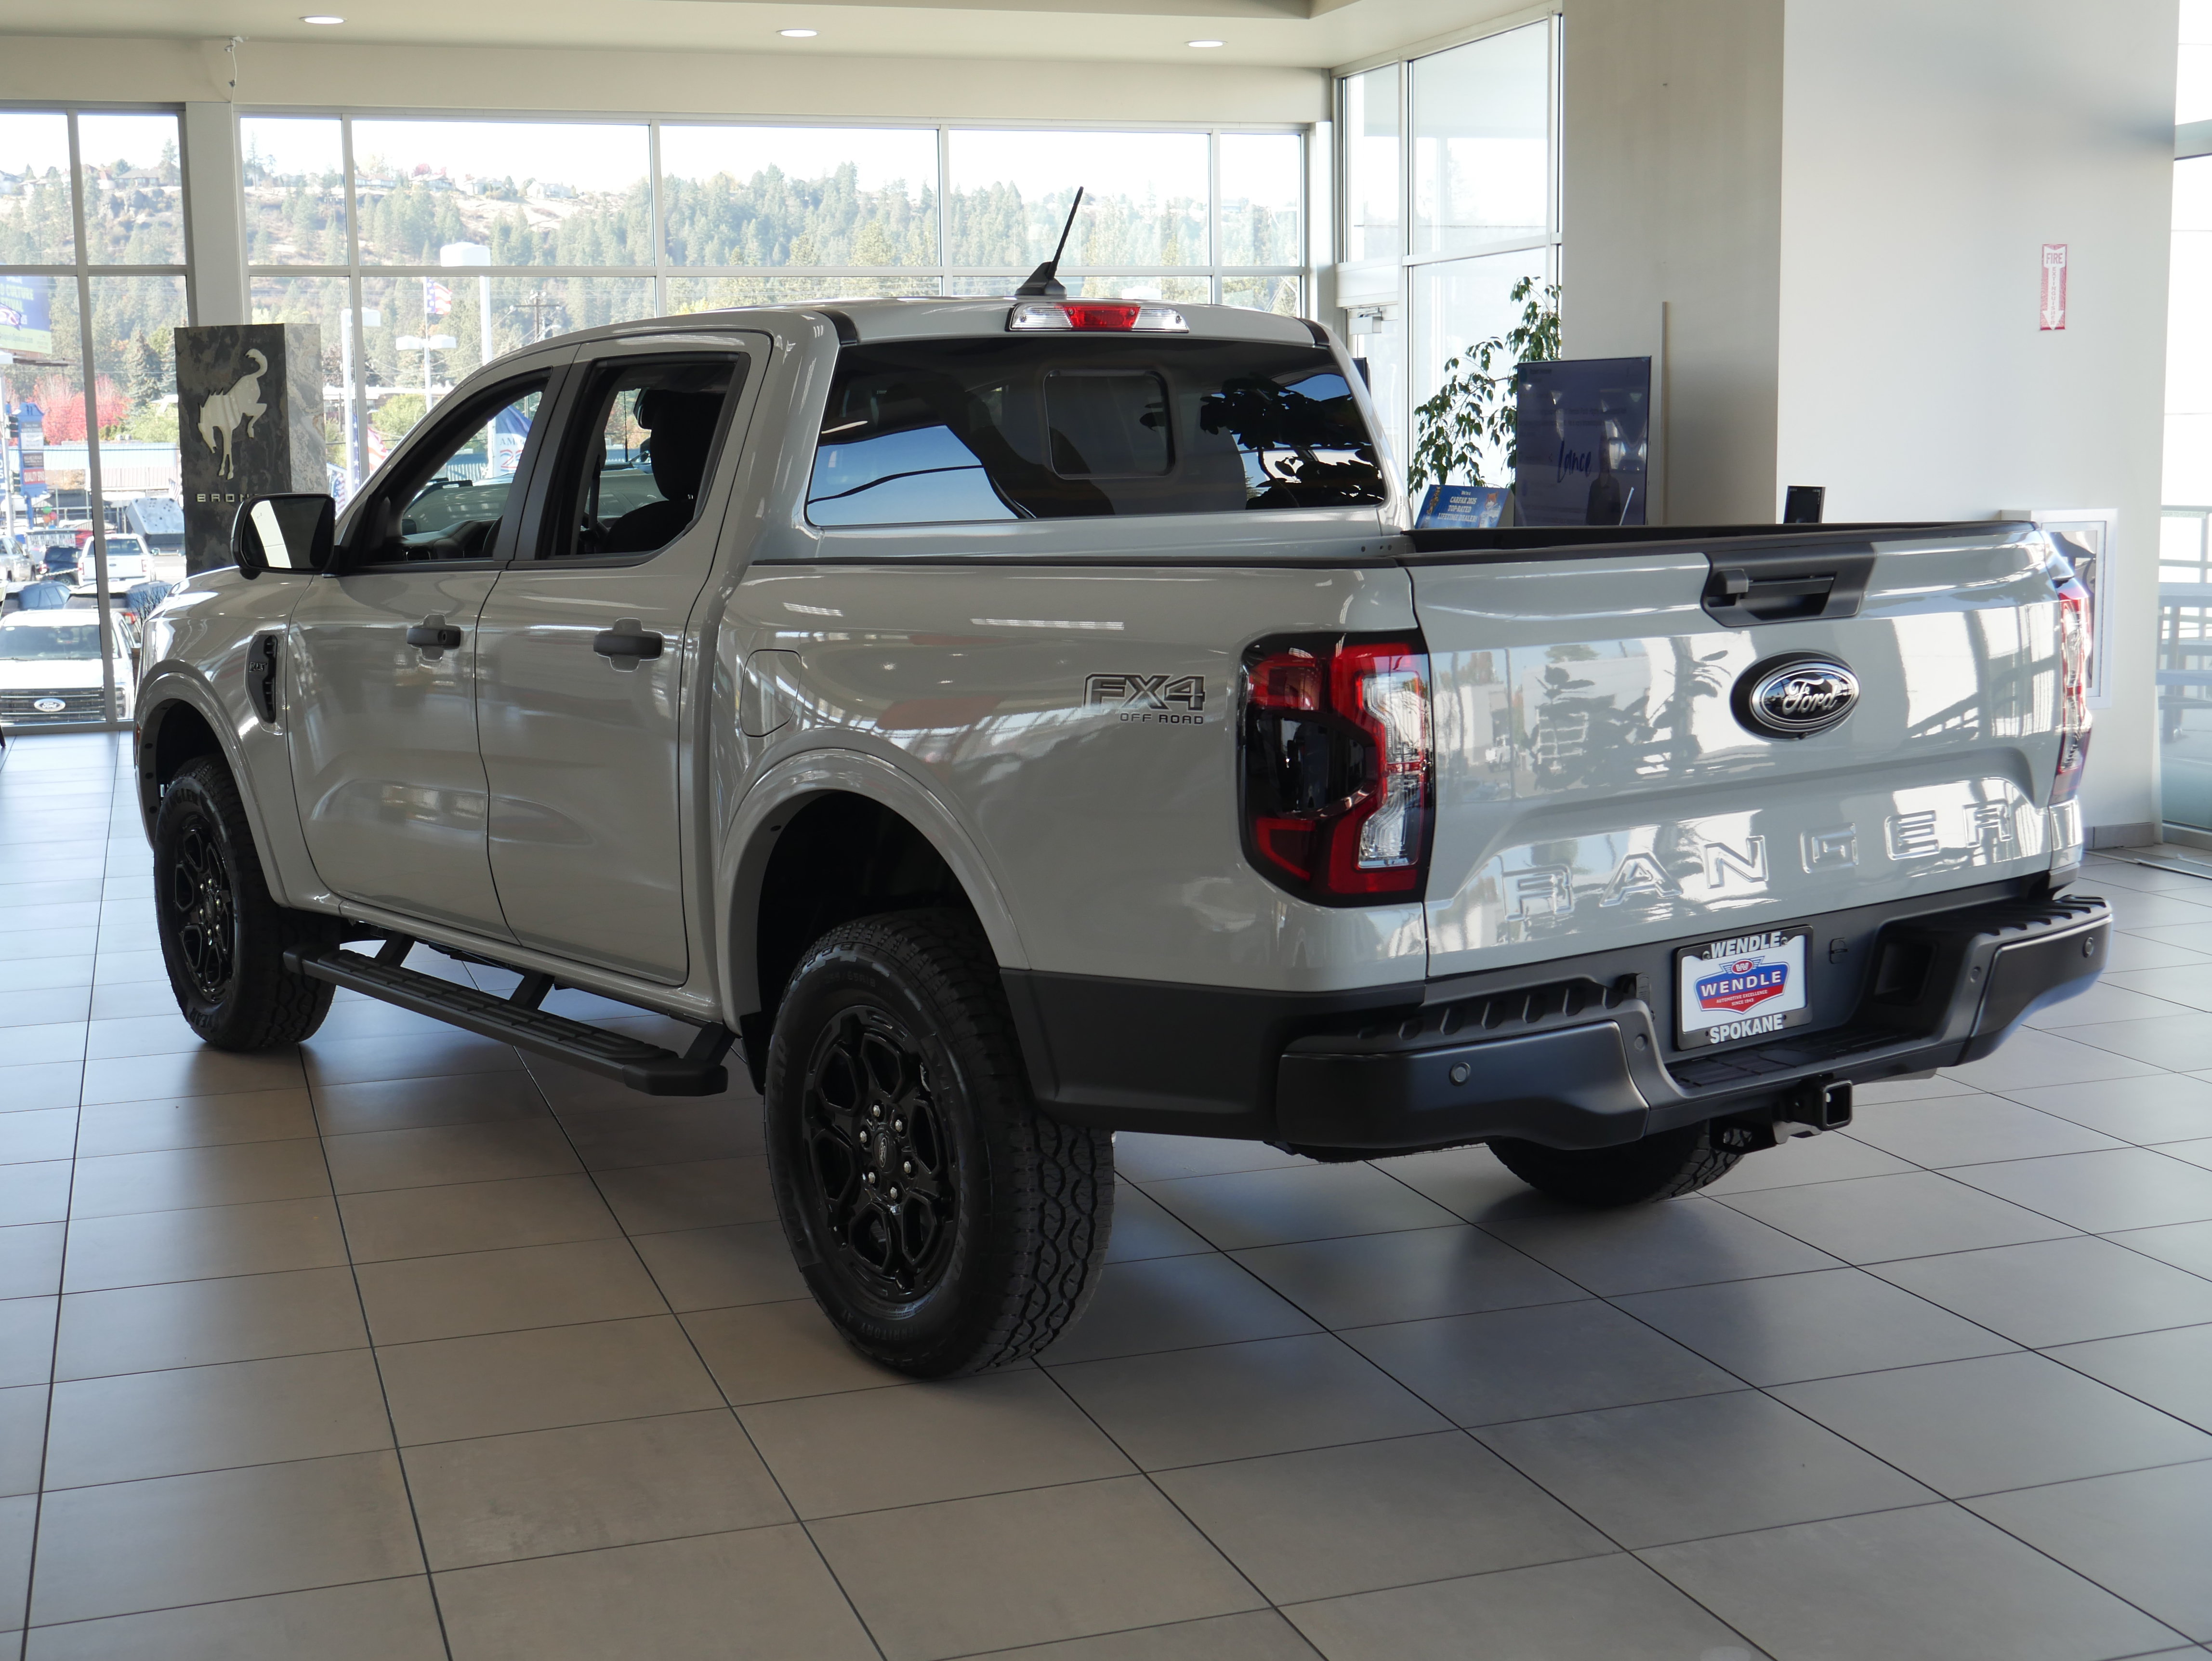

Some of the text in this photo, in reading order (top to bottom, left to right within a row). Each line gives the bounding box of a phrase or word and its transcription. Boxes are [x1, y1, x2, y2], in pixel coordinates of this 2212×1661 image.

[2046, 253, 2063, 264] FIRE
[6, 284, 34, 300] CULTURE
[1557, 440, 1592, 484] Lance
[25, 471, 37, 482] QUALITY
[1437, 513, 1460, 521] LIFETIME
[1082, 672, 1206, 715] FX4
[1782, 678, 1838, 715] Ford
[1120, 712, 1204, 725] OFF ROAD
[1502, 797, 2013, 921] RANGER
[1711, 932, 1781, 959] WENDLE
[1736, 962, 1750, 971] W
[1701, 971, 1781, 997] WENDLE
[1716, 989, 1768, 1003] AUTOMOTIVE EXCELLENCE
[1710, 1014, 1783, 1044] SPOKANE
